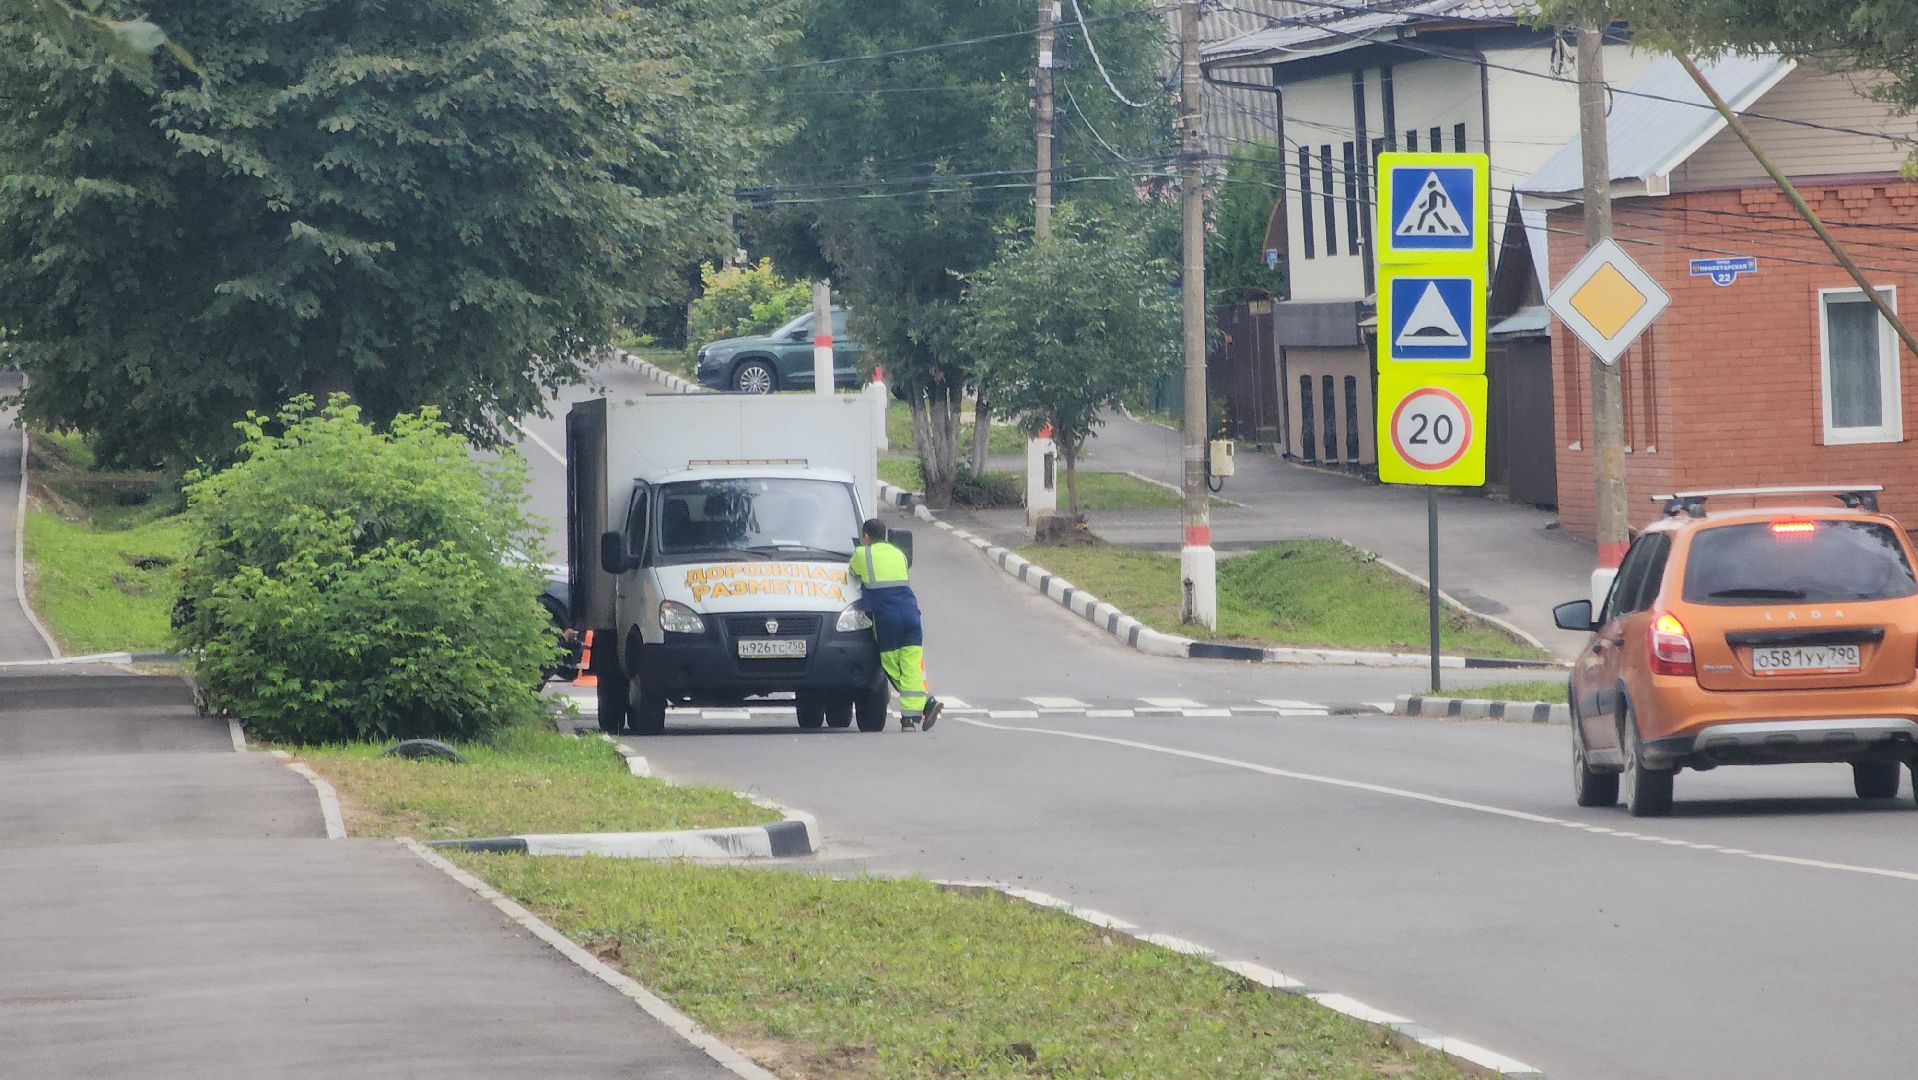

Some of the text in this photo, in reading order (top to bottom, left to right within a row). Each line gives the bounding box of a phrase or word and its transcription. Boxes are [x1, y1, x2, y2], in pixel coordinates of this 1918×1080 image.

[1718, 273, 1731, 282] 22
[1409, 413, 1453, 445] 20
[685, 563, 848, 588] ДОРОЖНАЯ
[691, 579, 847, 603] РАЗМЕТКА
[1764, 610, 1844, 621] LADA
